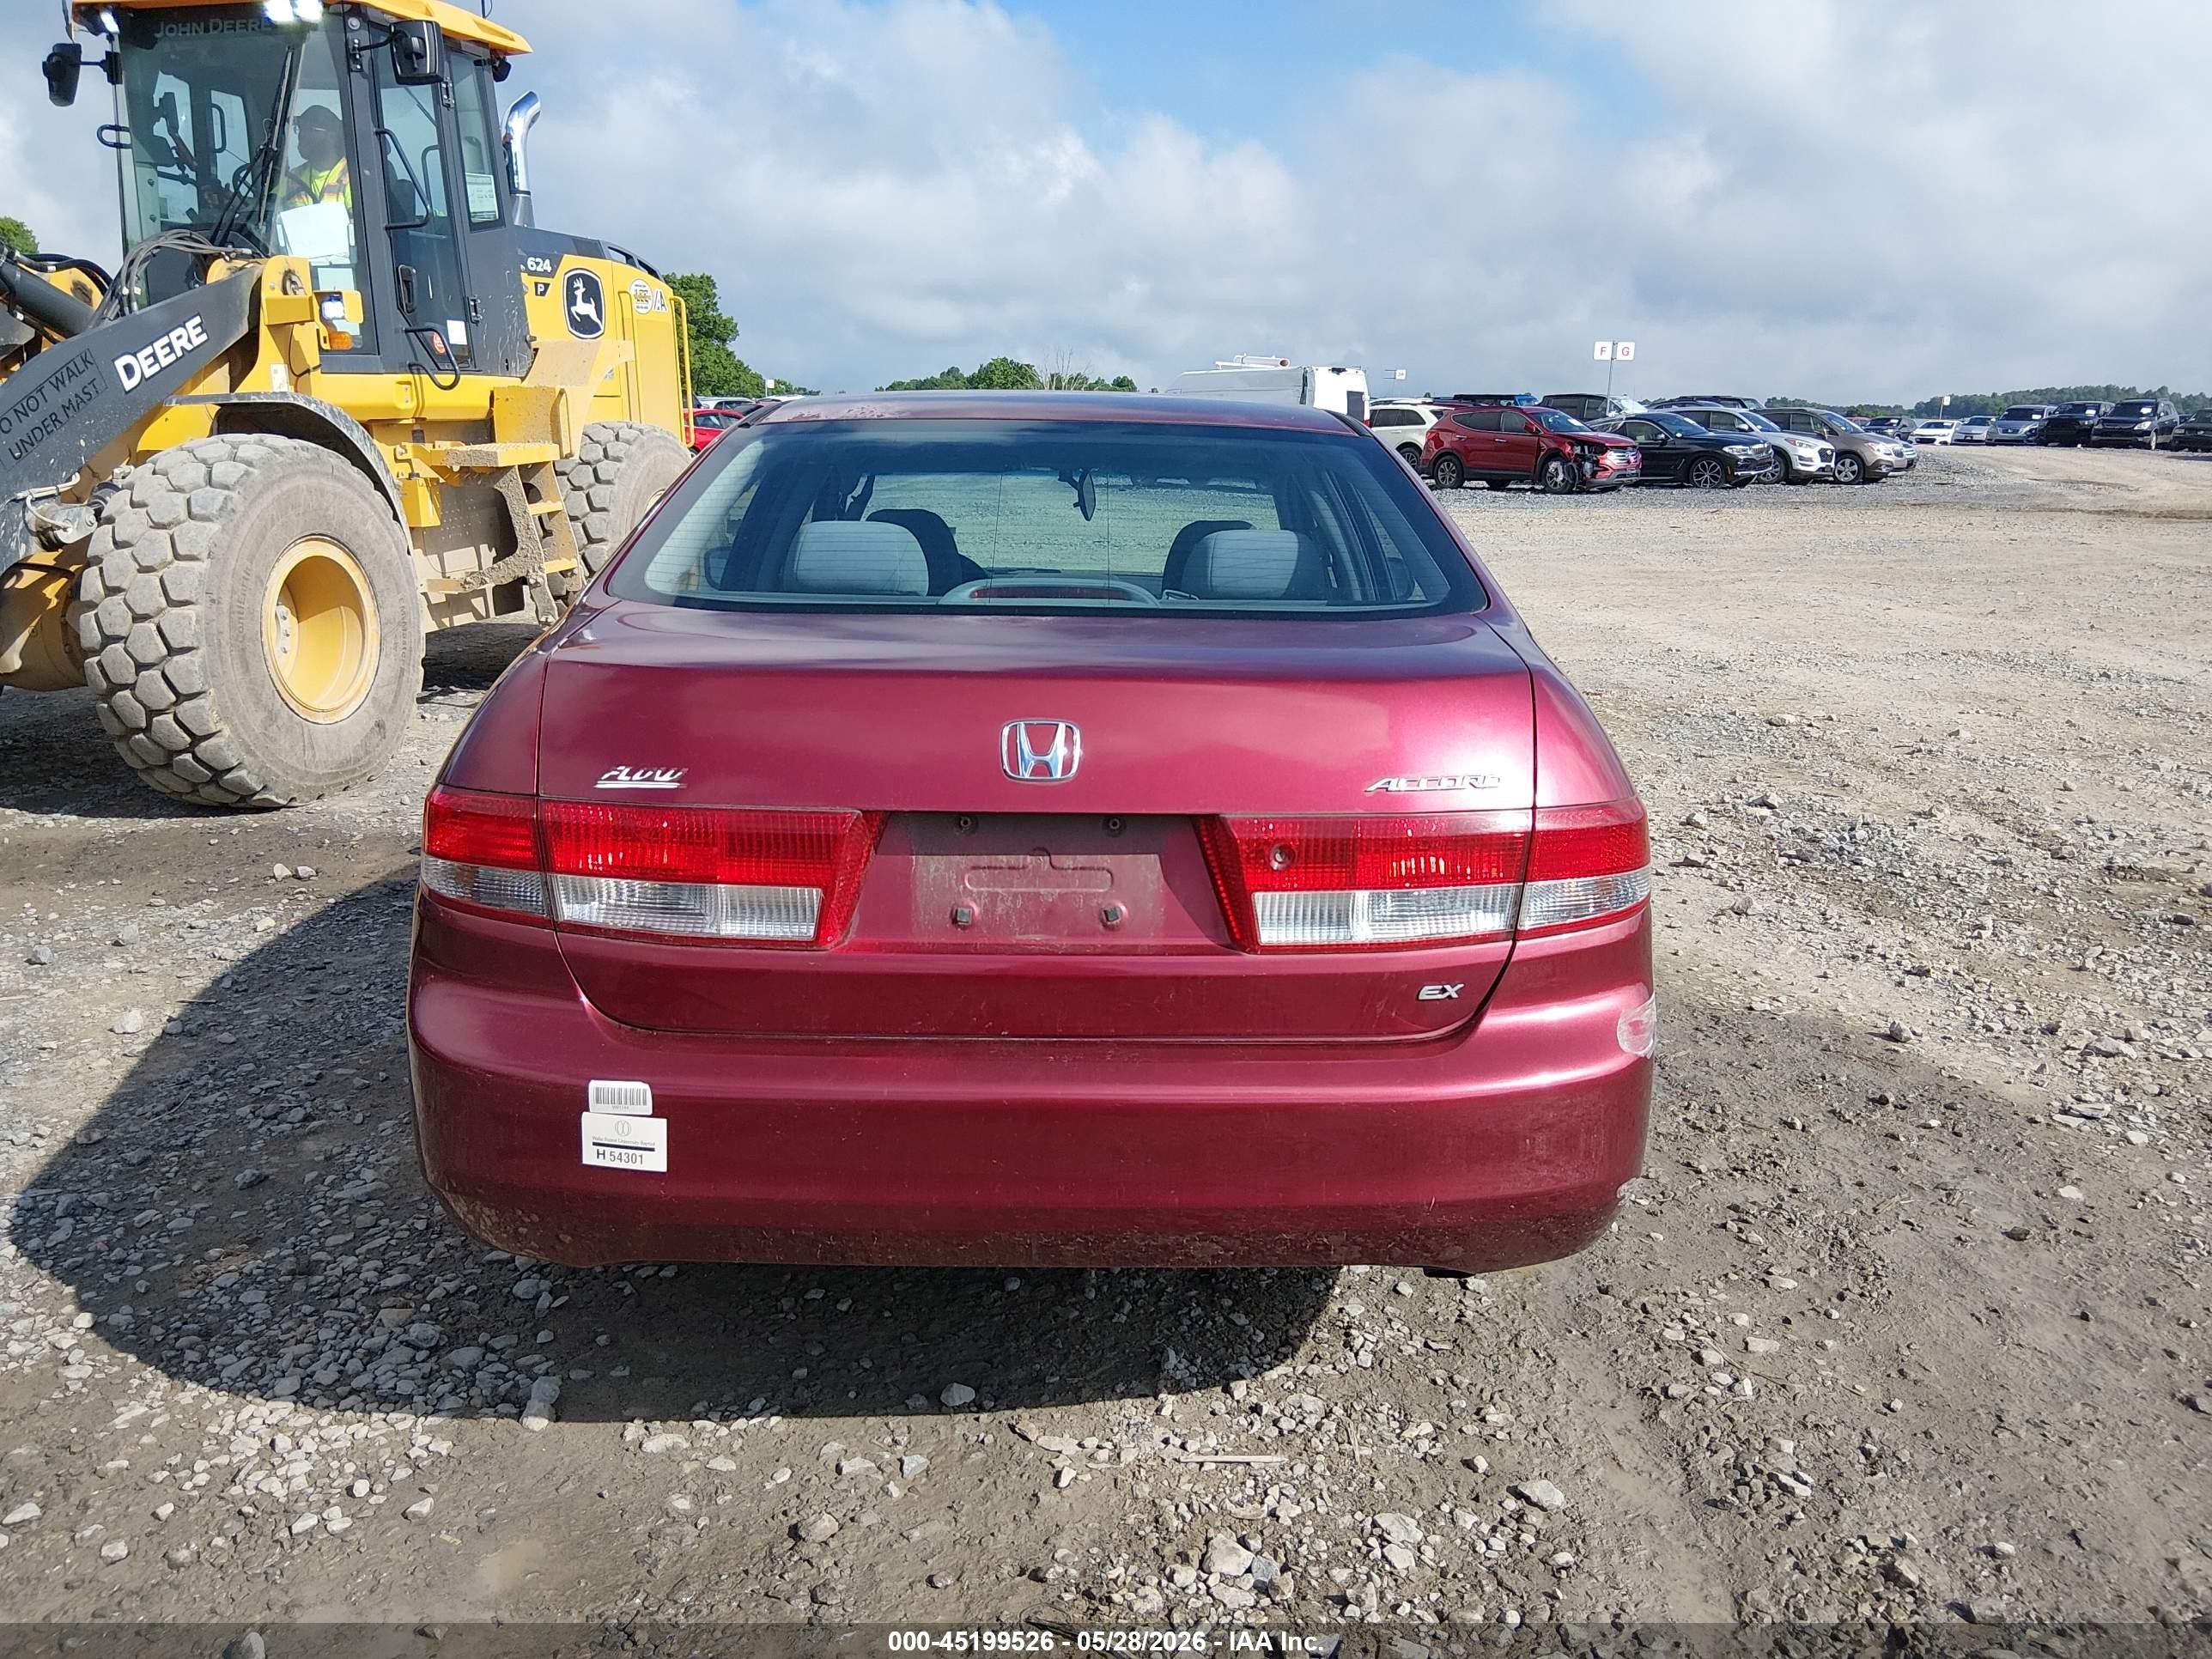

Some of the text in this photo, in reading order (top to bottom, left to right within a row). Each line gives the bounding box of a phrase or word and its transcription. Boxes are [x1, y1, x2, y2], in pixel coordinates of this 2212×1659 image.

[155, 18, 271, 39] JOHN DEERE
[526, 257, 552, 273] 624
[537, 283, 545, 295] P
[113, 313, 209, 392] DEERE
[1600, 346, 1607, 356] F
[1621, 346, 1630, 356] G
[0, 352, 94, 434] O NOT WALK
[8, 378, 100, 461] UNDER MAST
[1364, 775, 1501, 793] ACCORD
[1418, 983, 1465, 1000] EX
[597, 1149, 643, 1165] H 54301
